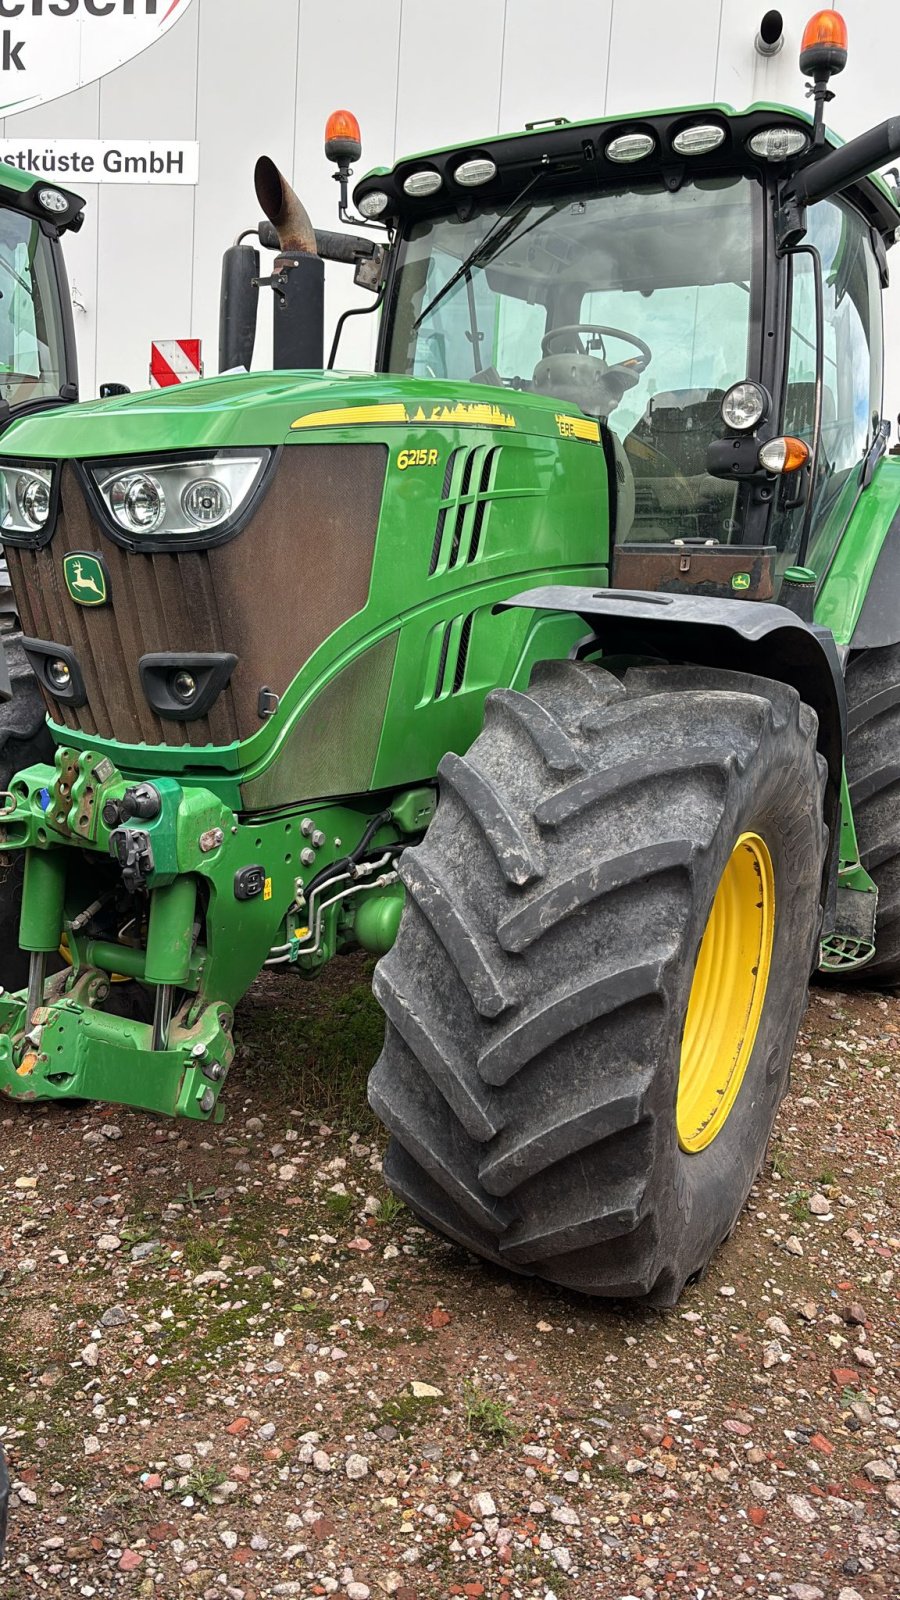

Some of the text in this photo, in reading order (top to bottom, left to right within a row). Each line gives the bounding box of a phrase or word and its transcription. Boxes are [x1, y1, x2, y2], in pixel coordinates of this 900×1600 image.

[3, 30, 26, 71] k
[0, 149, 184, 174] stküste GmbH
